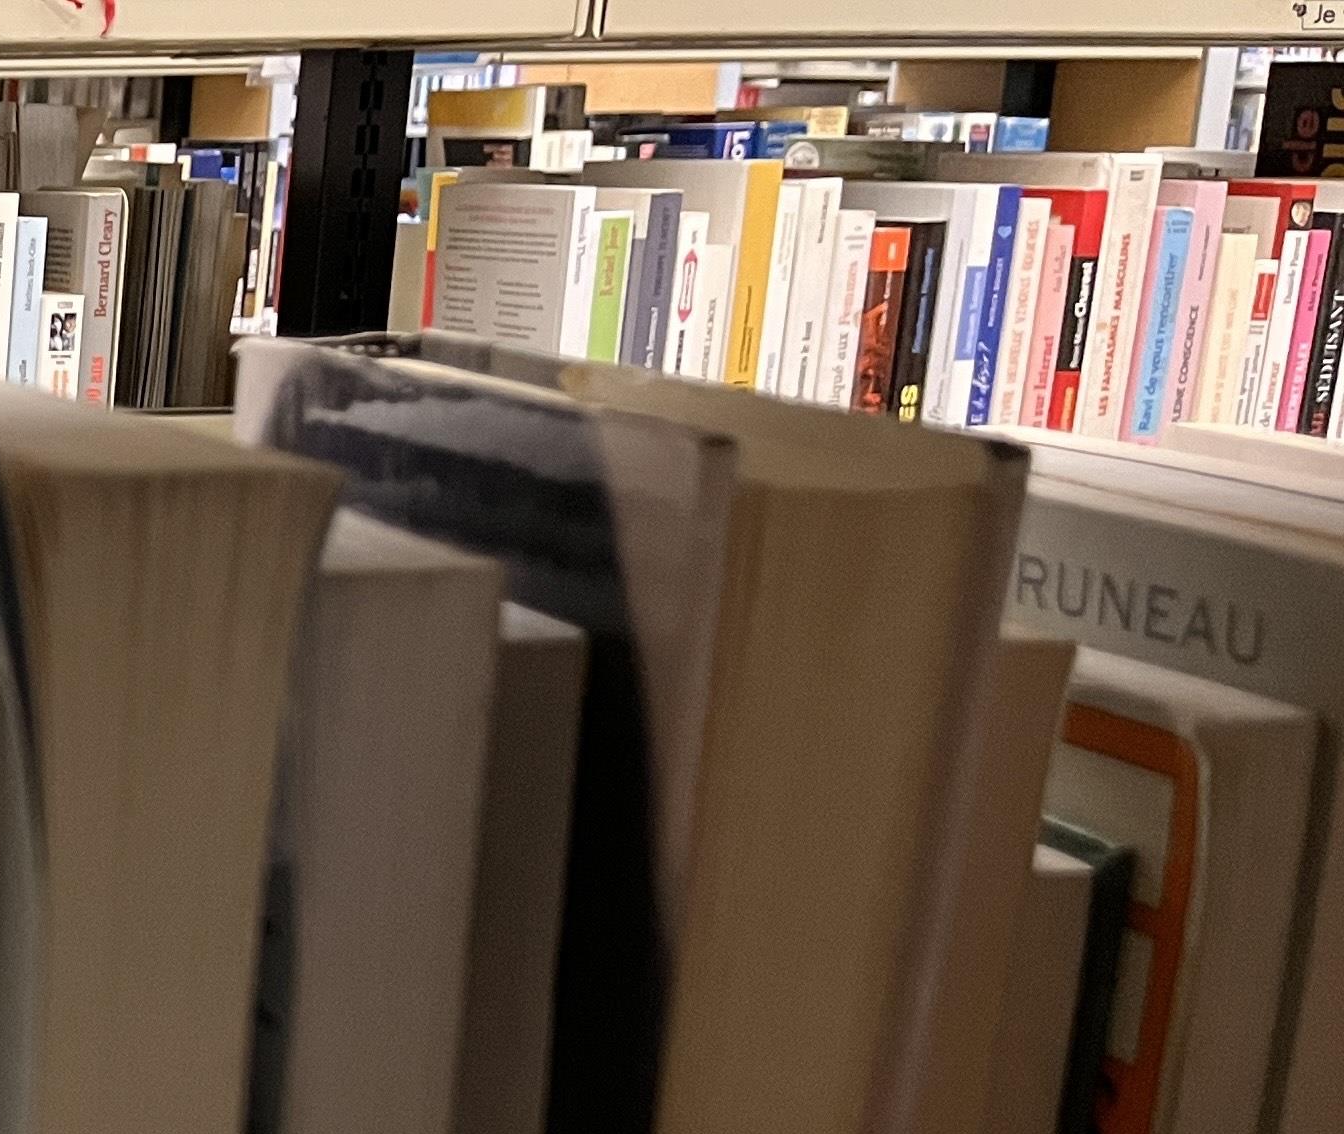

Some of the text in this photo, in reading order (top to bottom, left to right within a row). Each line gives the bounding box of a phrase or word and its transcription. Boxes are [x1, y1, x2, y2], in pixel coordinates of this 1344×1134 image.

[89, 208, 117, 383] ans Bernard Cleary
[837, 261, 858, 360] aux Femmes
[1076, 262, 1094, 318] Charest
[1138, 253, 1178, 432] Ravi de vous rencontrer
[1034, 335, 1054, 391] Internet
[1014, 552, 1265, 667] RUNEAU
